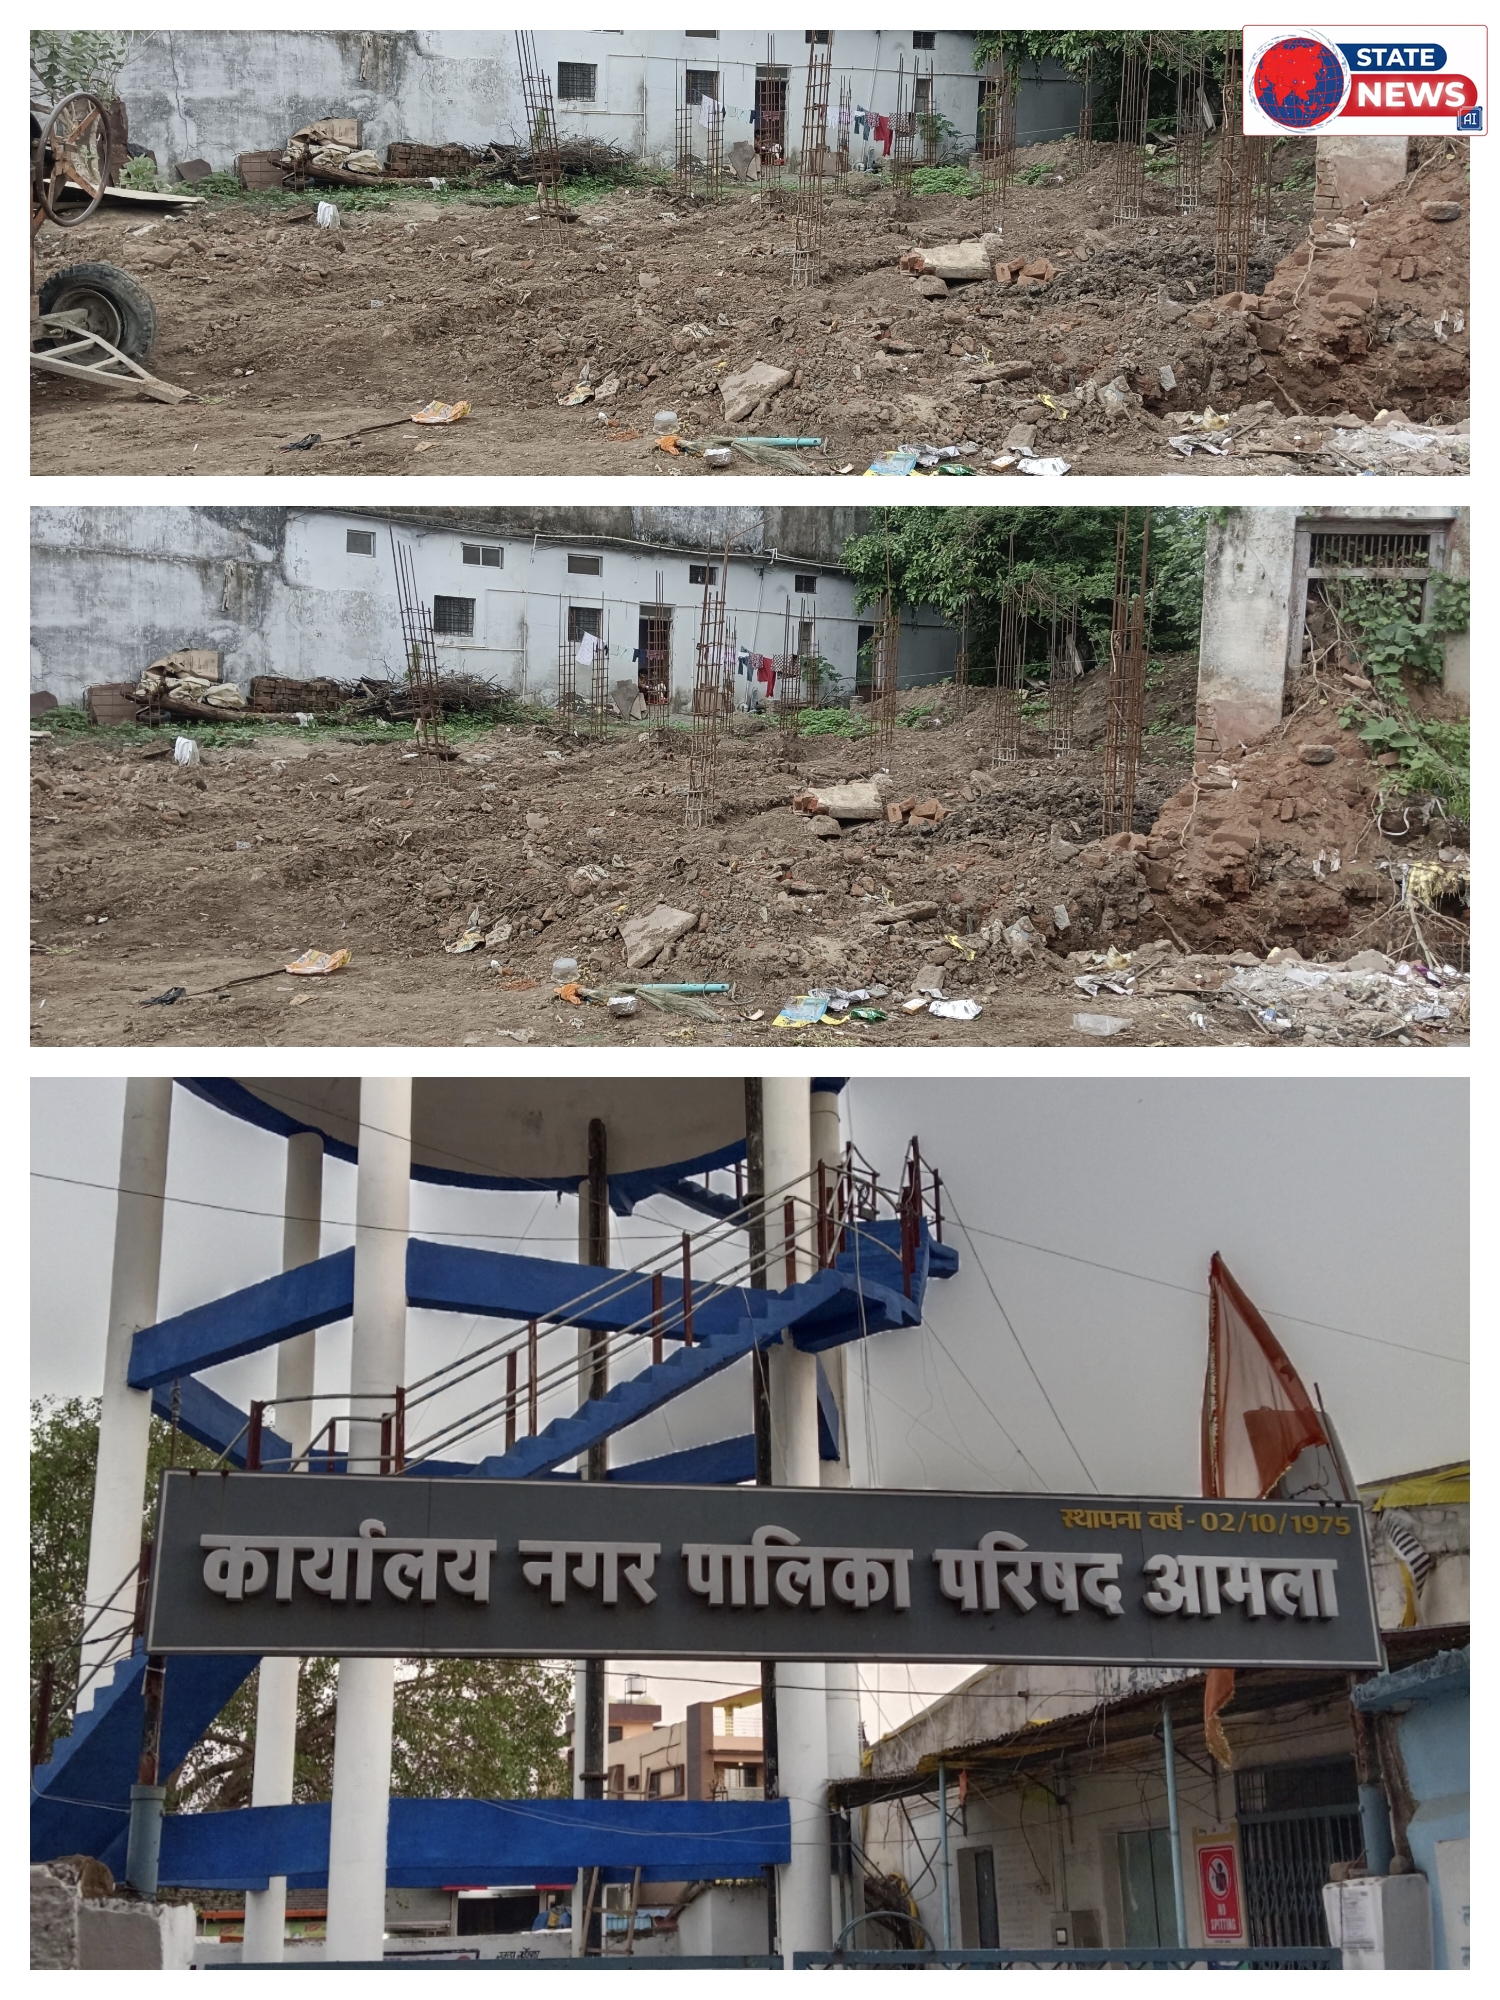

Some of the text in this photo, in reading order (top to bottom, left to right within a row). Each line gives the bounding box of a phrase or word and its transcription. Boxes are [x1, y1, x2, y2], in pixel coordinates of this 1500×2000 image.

[1060, 1508, 1143, 1531] स्थापना
[1201, 1510, 1352, 1536] 02/10/1975
[200, 1518, 1340, 1619] कार्यालय नगर पालिका परिषद आमला
[1217, 1903, 1227, 1916] NO
[1210, 1918, 1237, 1931] SPITTING
